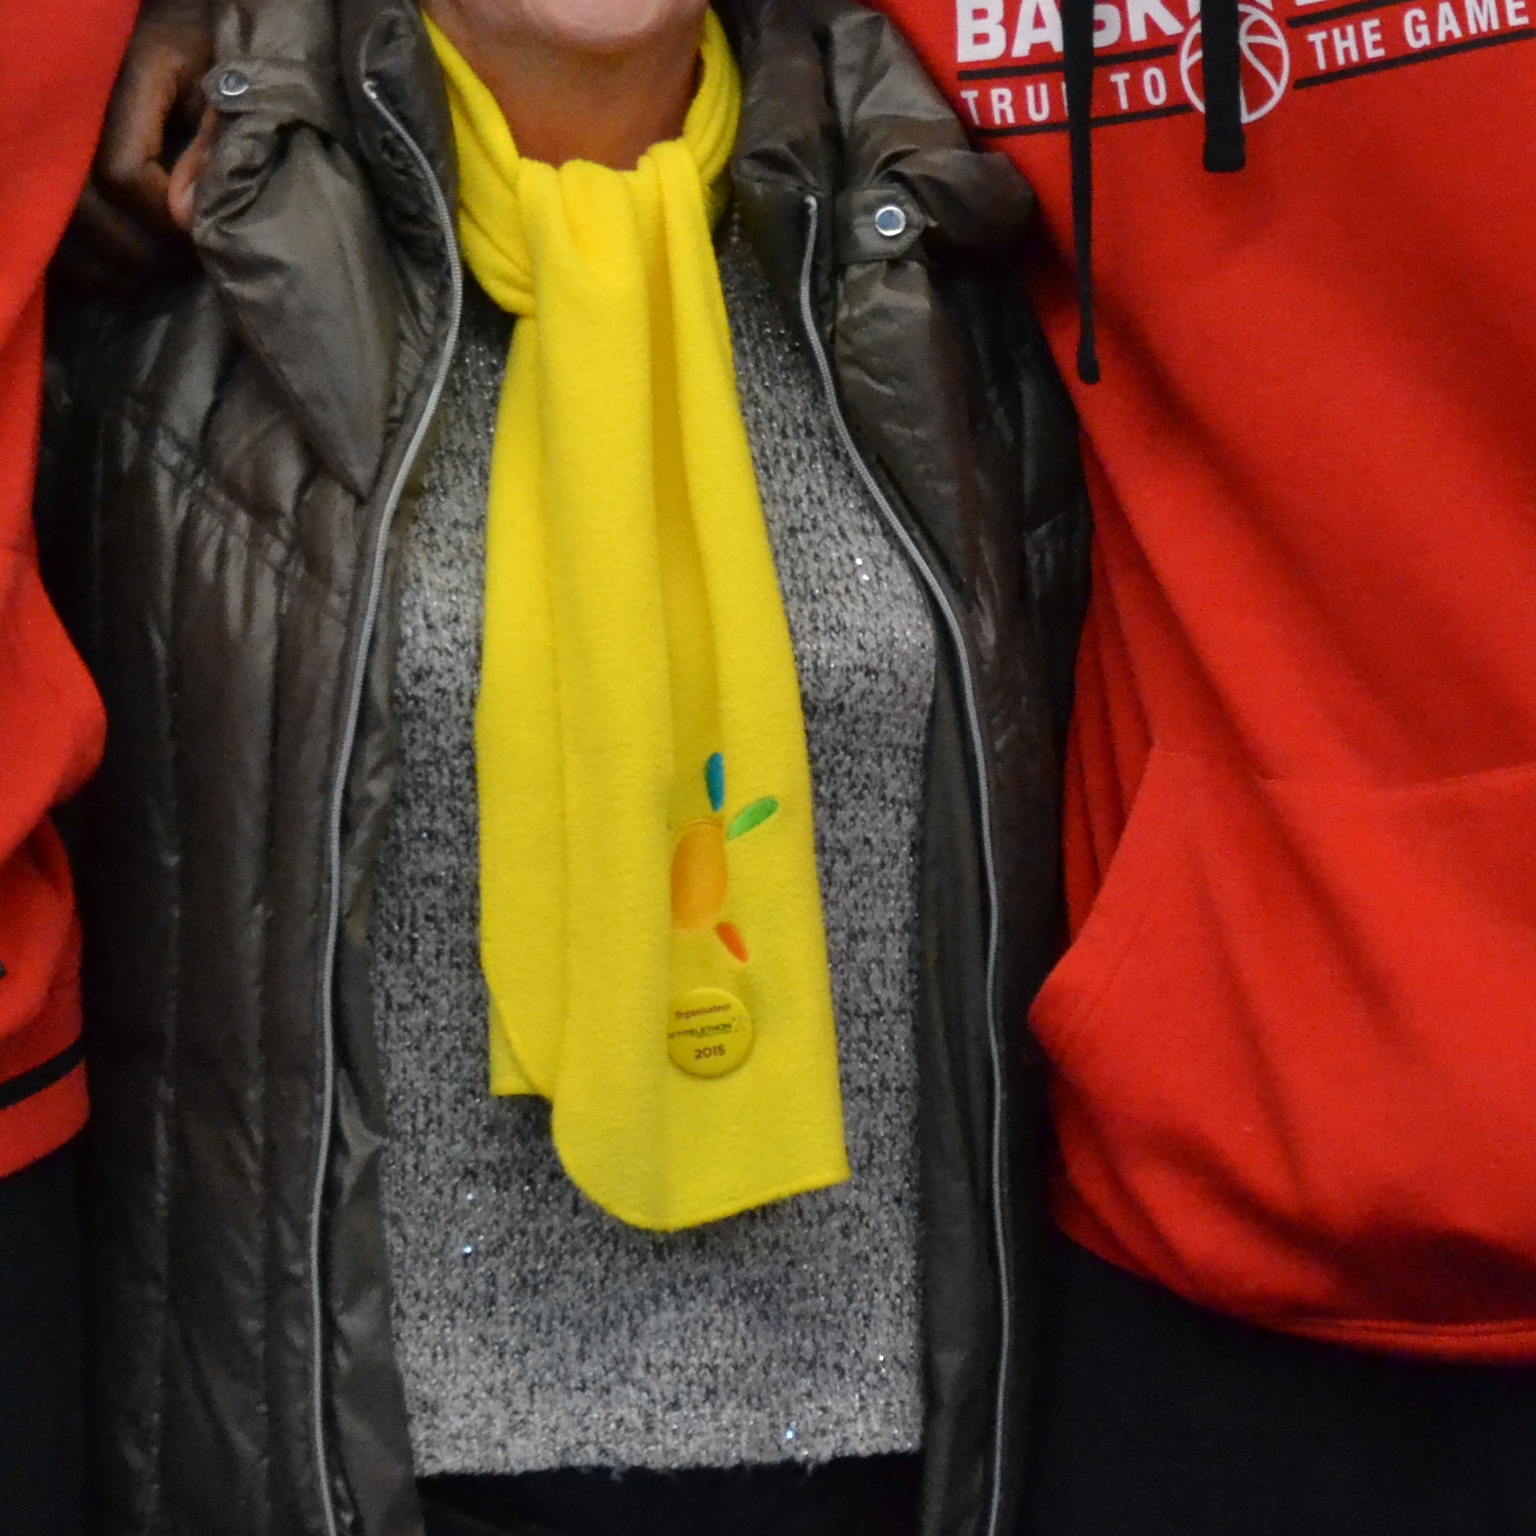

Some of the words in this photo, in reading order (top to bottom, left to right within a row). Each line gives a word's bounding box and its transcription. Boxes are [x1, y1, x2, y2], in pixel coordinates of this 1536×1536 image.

[960, 80, 1069, 127] TRU
[1110, 67, 1167, 110] TO
[1307, 18, 1386, 71] THE
[694, 1044, 726, 1060] 2015
